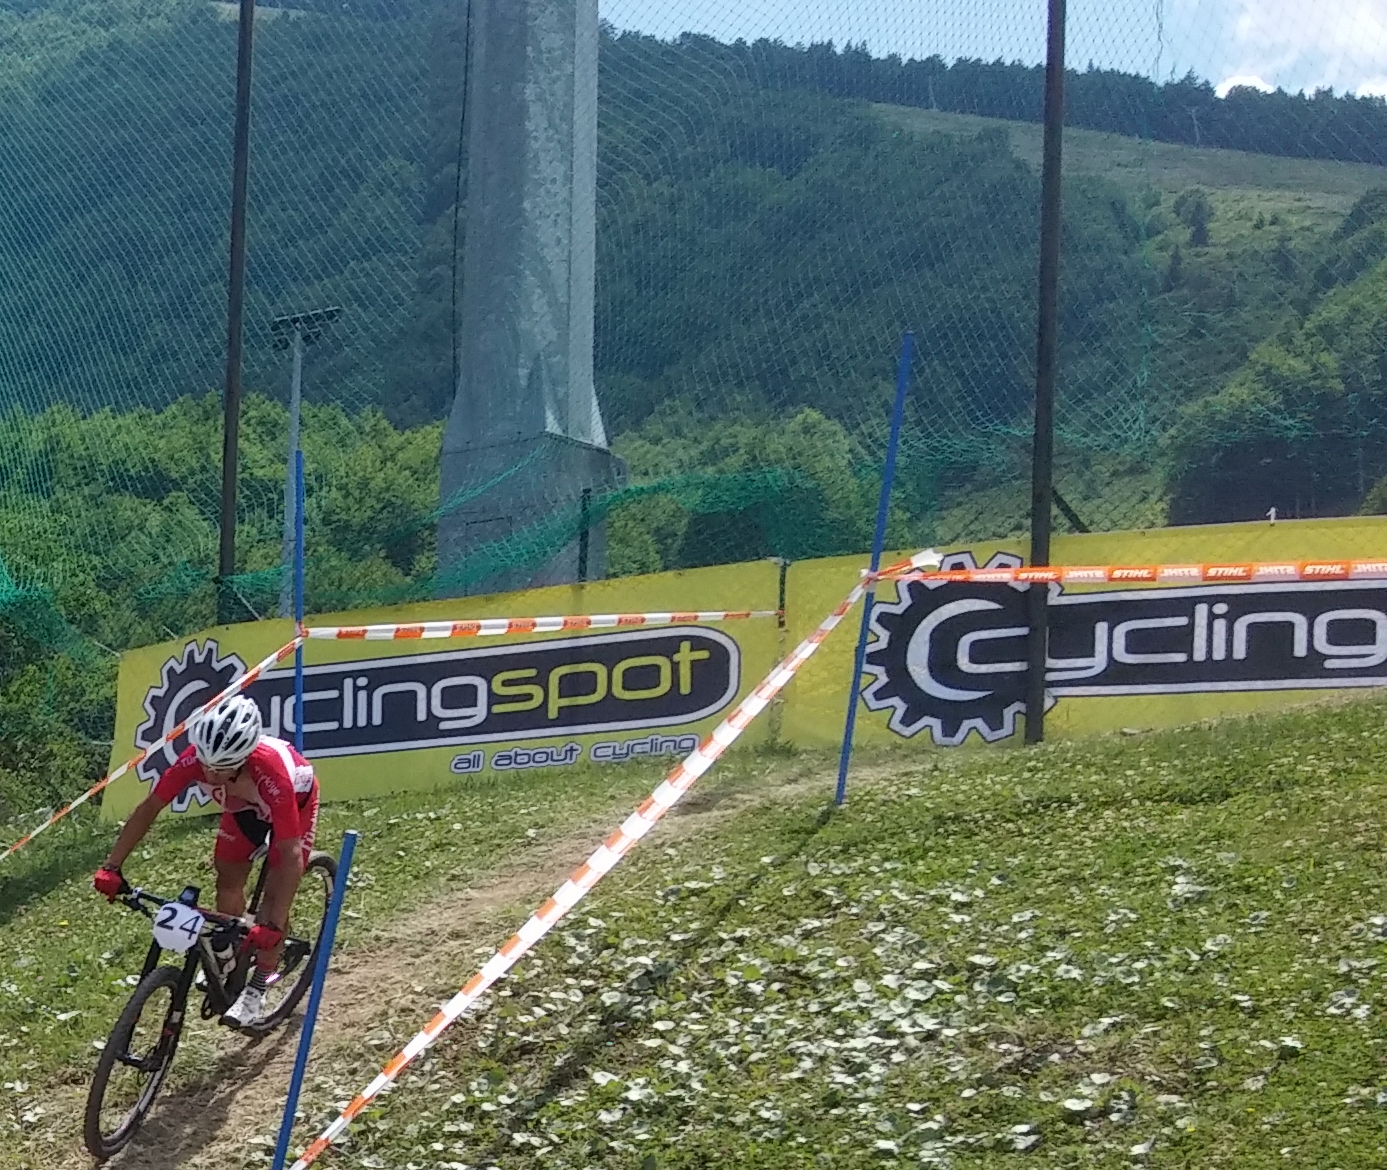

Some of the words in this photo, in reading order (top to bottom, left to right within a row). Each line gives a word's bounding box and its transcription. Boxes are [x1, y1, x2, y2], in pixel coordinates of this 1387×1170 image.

[1111, 569, 1153, 578] STIHL
[1207, 567, 1247, 577] STIHL
[1303, 564, 1345, 574] STIHL
[451, 752, 482, 771] all
[492, 743, 581, 767] about
[591, 735, 698, 761] cycling
[157, 907, 200, 940] 24
